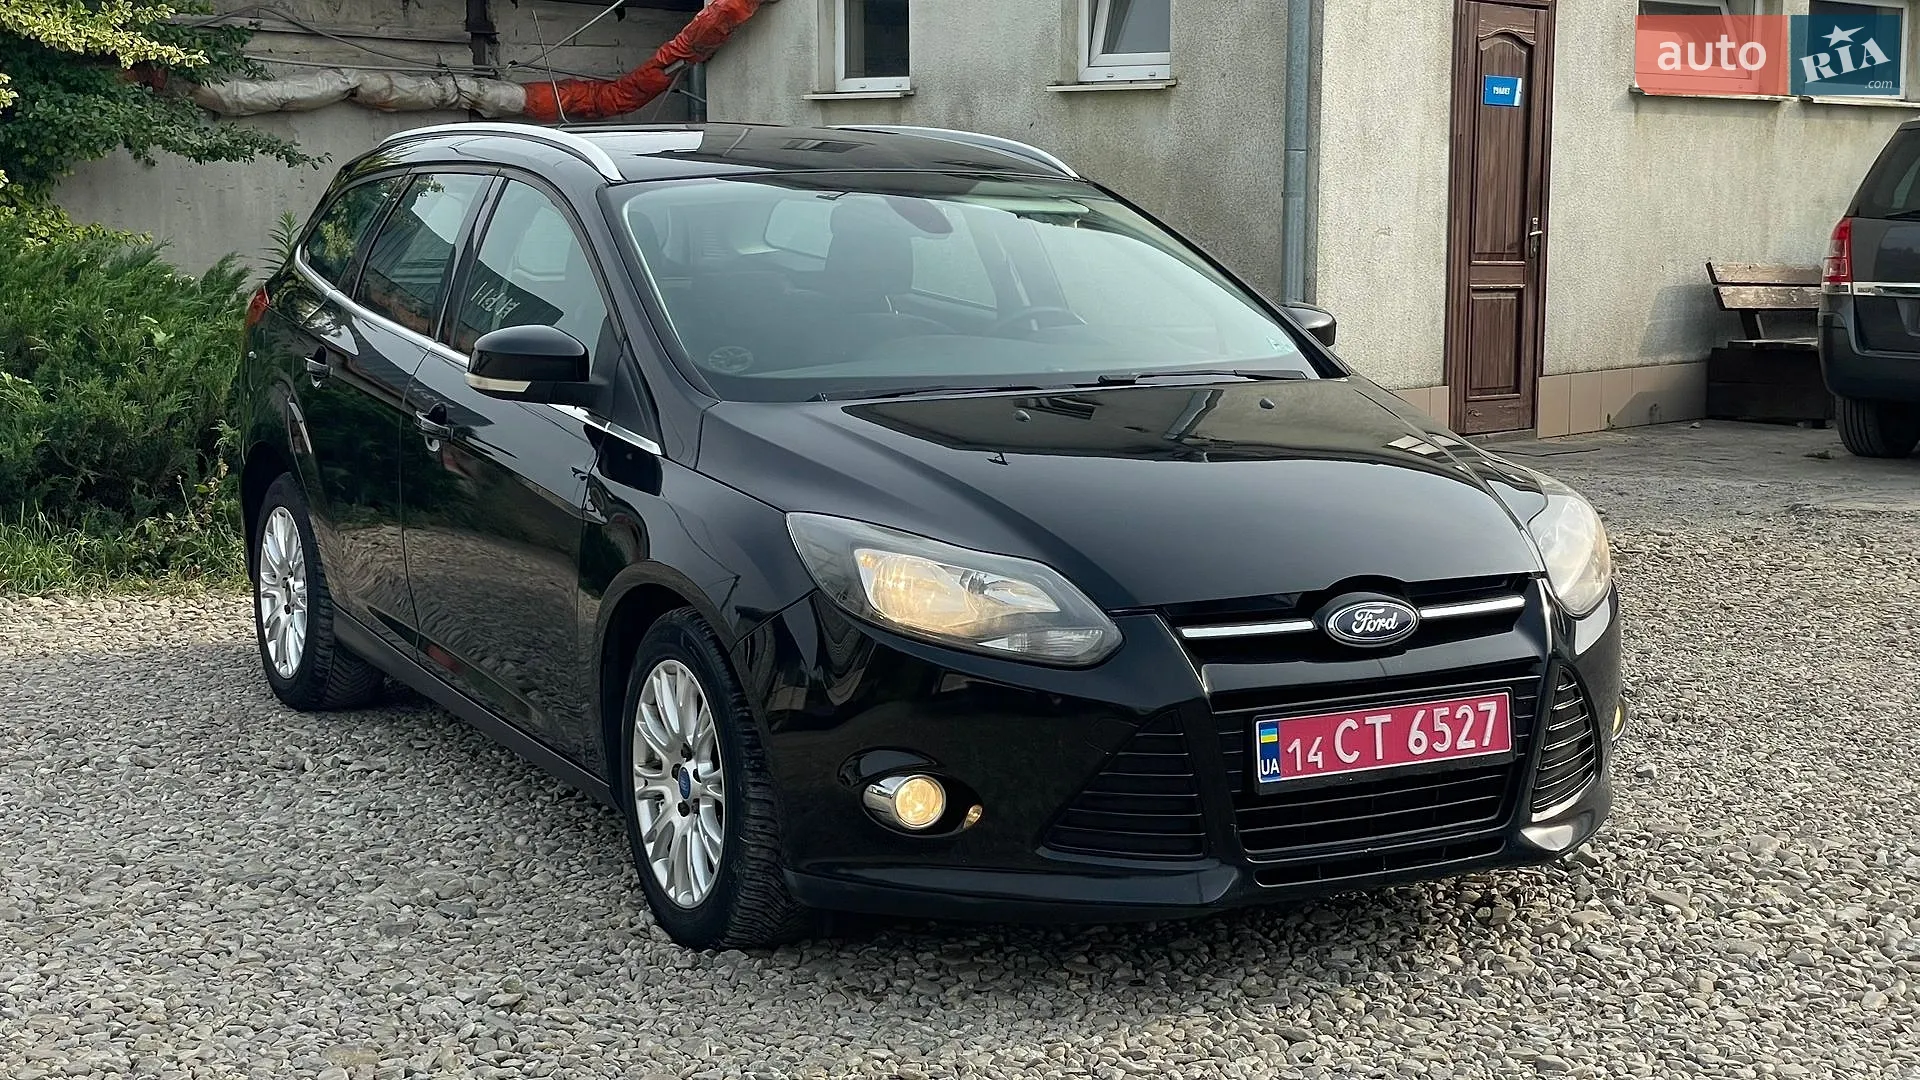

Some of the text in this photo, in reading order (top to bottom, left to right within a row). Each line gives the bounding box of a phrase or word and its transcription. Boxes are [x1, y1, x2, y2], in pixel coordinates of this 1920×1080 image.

[1351, 608, 1398, 634] Ford
[1287, 701, 1497, 771] 14 CT 6527
[1260, 758, 1280, 776] UA
